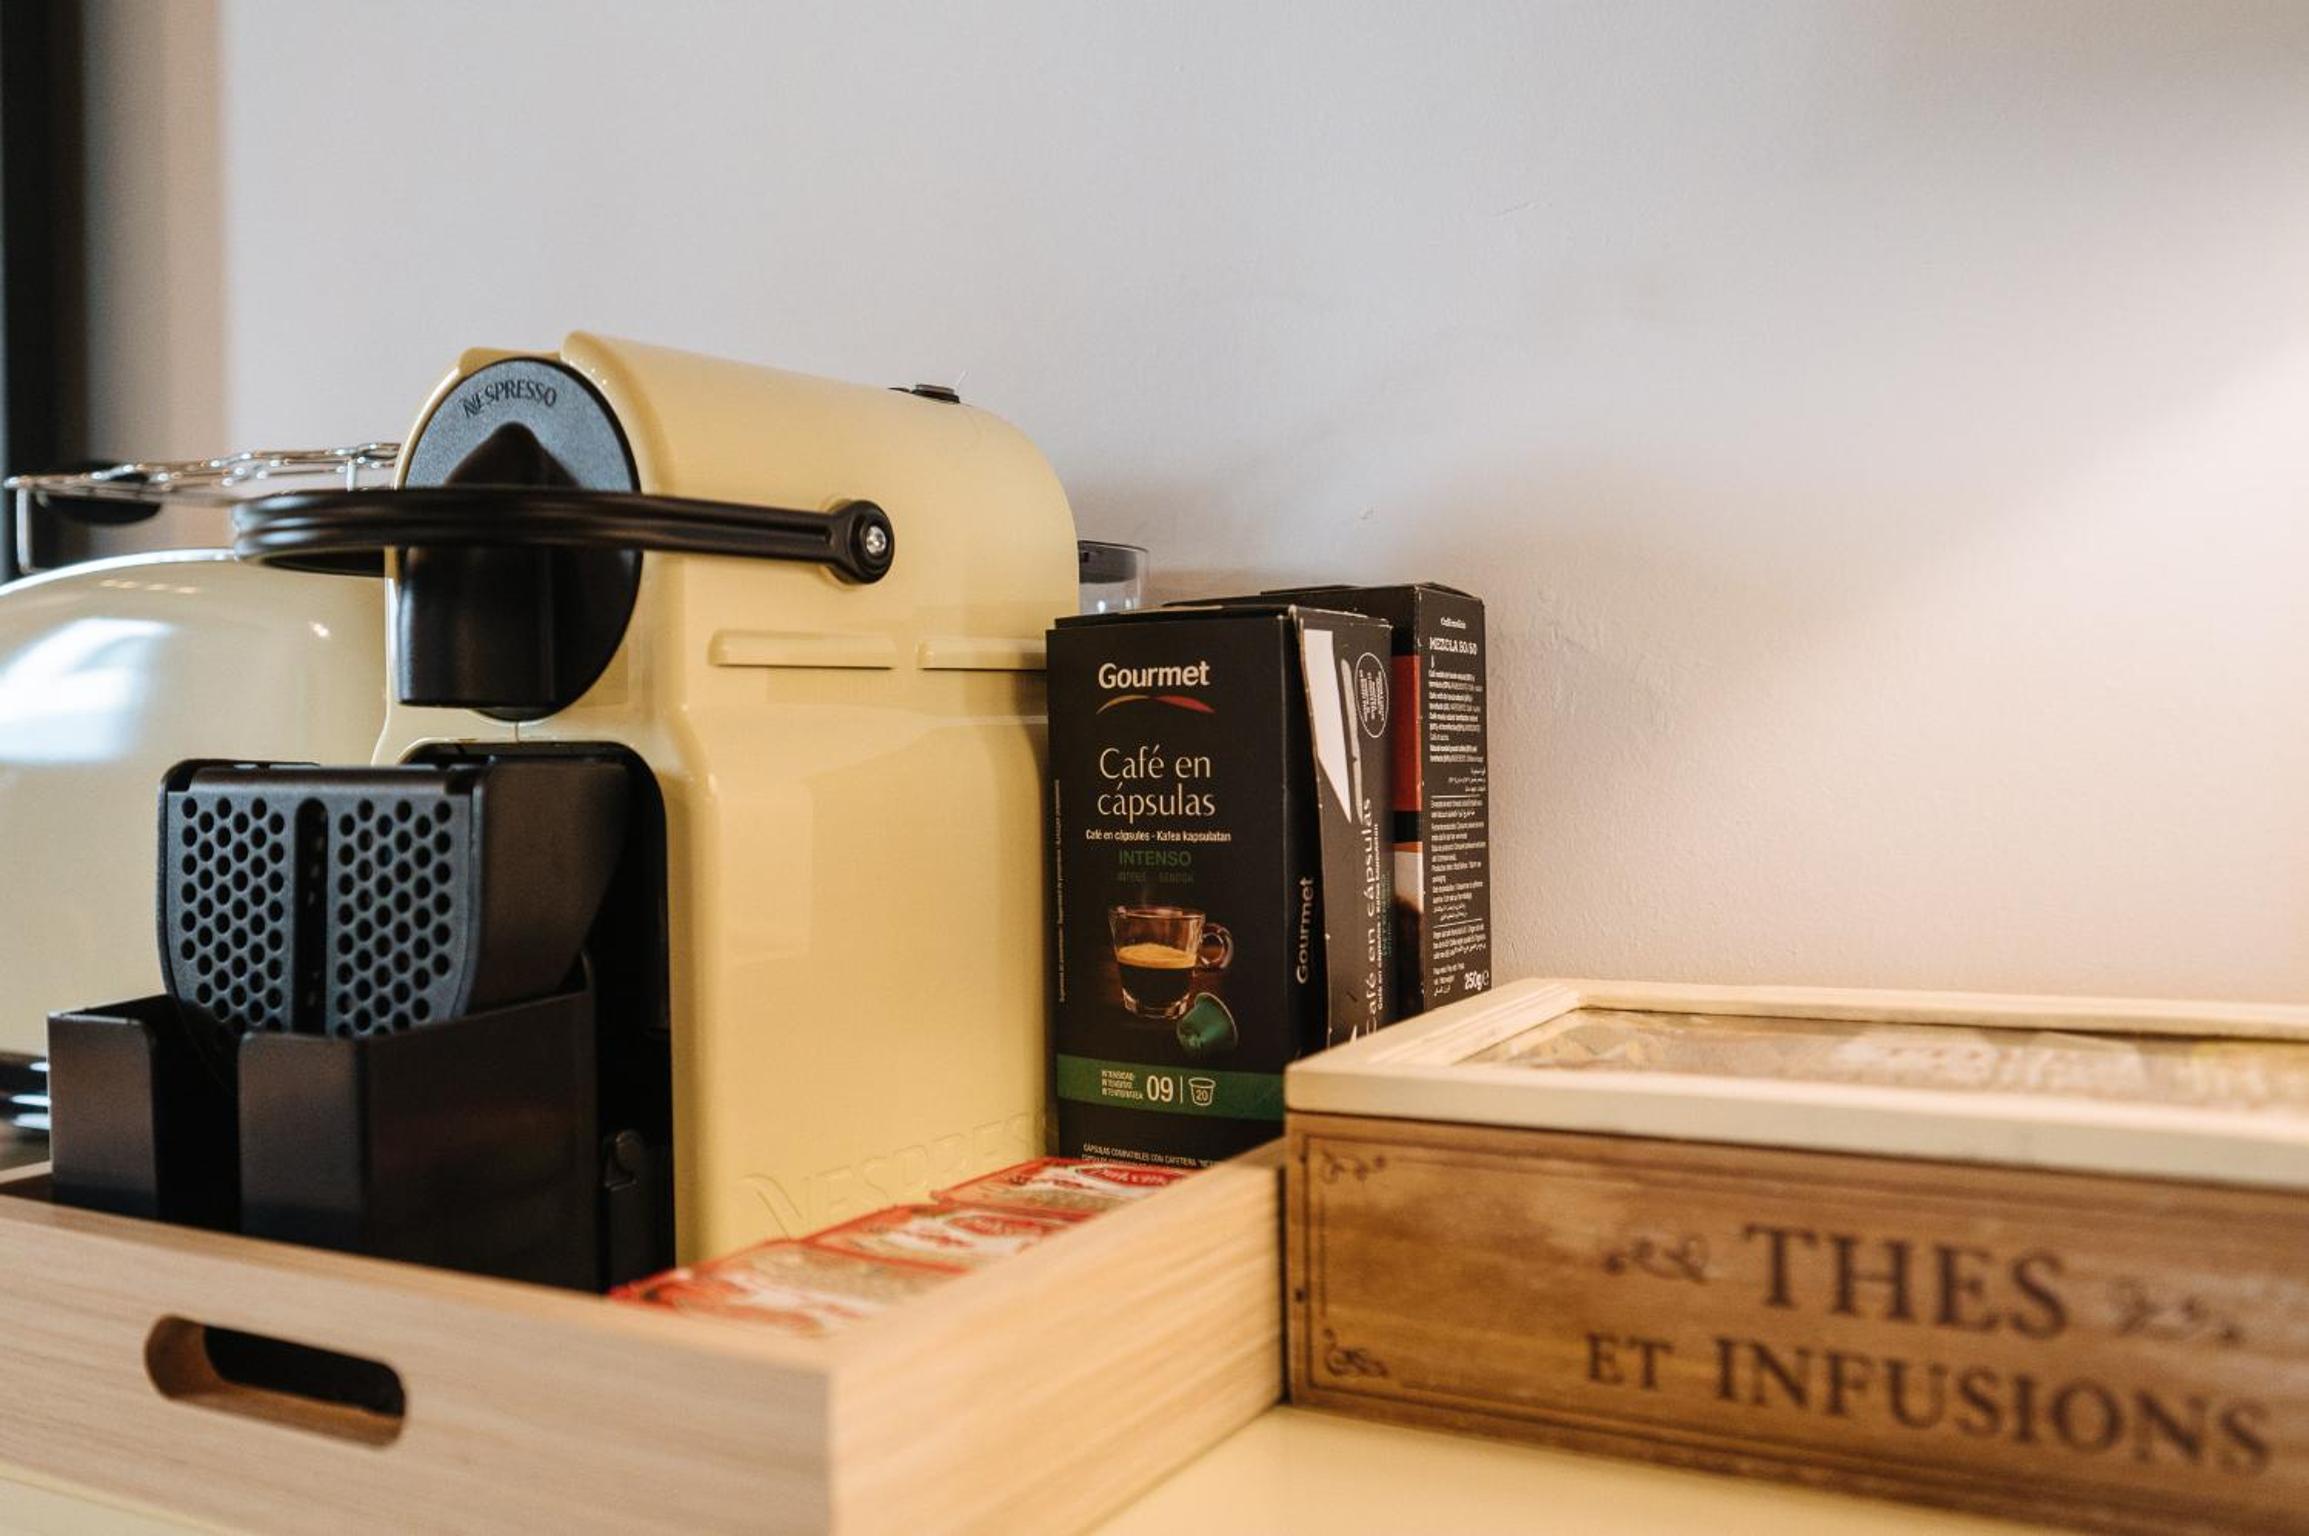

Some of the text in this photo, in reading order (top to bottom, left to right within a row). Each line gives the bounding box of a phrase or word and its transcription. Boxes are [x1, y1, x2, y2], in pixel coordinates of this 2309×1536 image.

[459, 379, 557, 418] NESPRESSO
[1098, 661, 1211, 689] Gourmet
[1099, 744, 1211, 780] Café en
[1096, 782, 1216, 824] cápsulas
[1103, 831, 1113, 840] en
[1119, 849, 1192, 867] INTENSO
[1361, 798, 1376, 917] cápsulas
[1297, 877, 1314, 984] Gourmet
[1367, 928, 1376, 962] en
[1146, 1075, 1209, 1103] 09 20
[1744, 1221, 2068, 1340] THES
[1585, 1331, 2274, 1477] ET INFUSIONS
